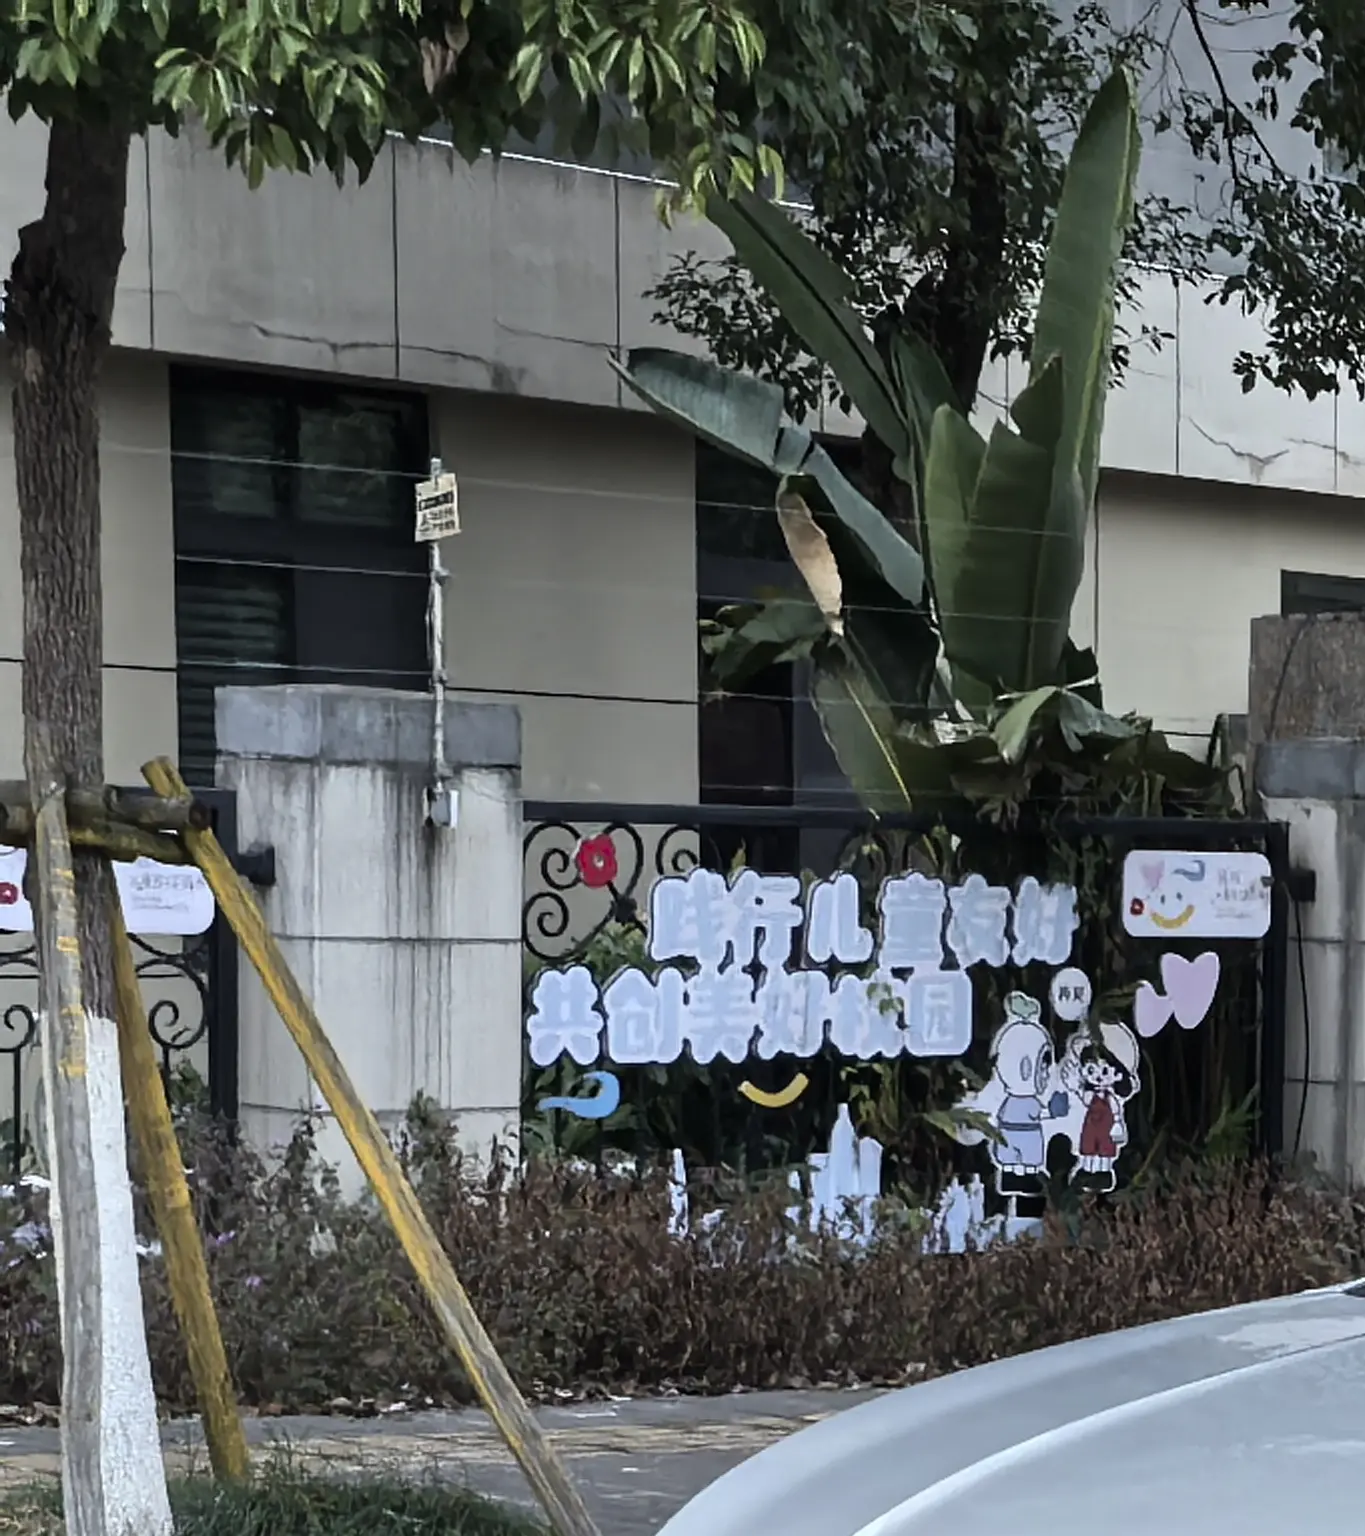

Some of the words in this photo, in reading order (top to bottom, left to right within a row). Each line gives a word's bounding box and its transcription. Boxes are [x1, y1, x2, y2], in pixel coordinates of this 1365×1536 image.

[528, 968, 972, 1066] 共创美好校园
